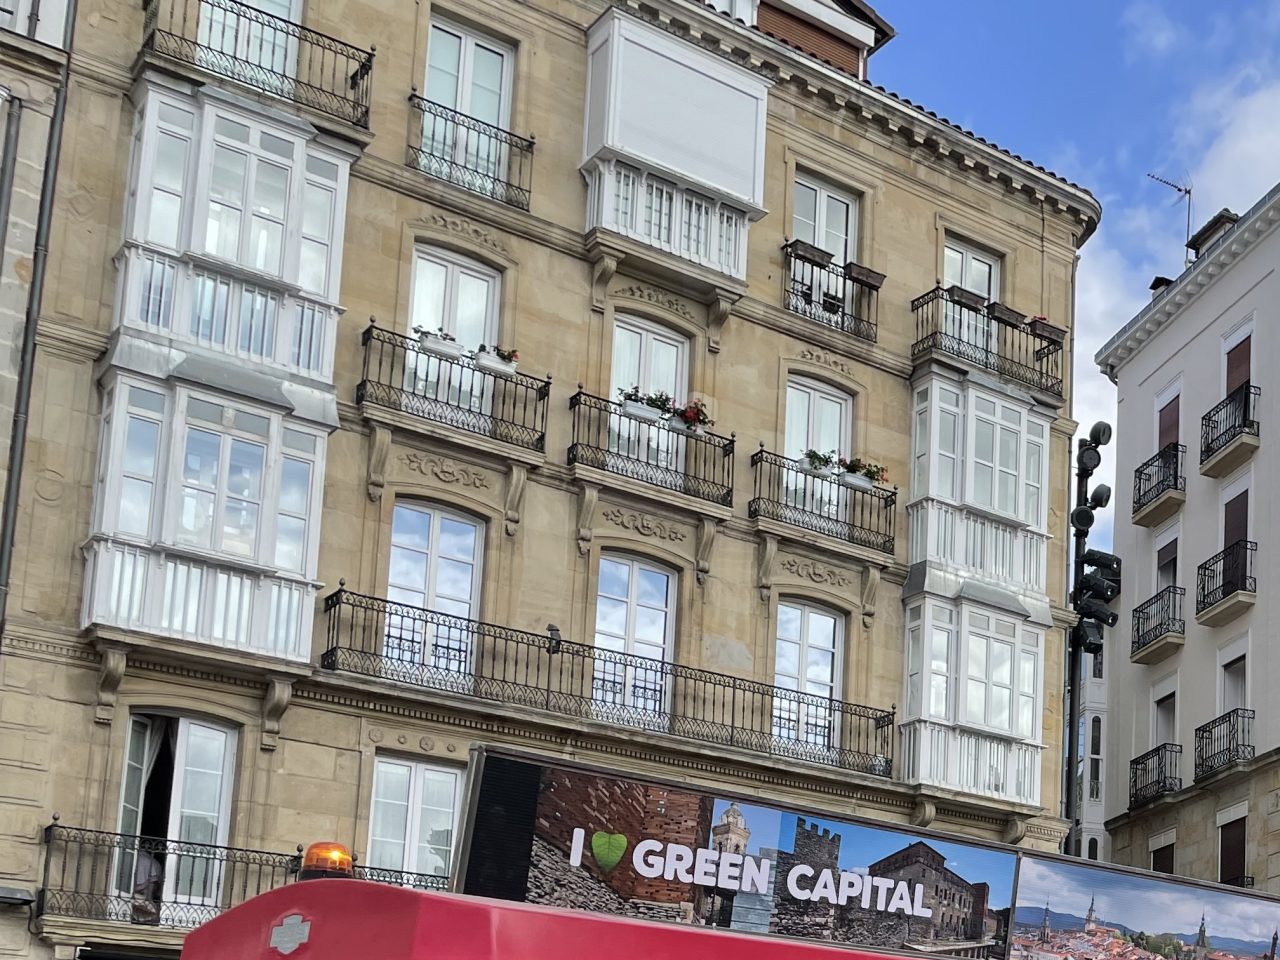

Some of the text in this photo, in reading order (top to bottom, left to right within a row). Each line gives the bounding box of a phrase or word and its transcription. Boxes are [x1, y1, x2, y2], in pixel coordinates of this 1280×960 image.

[569, 827, 933, 918] I GREEN CAPITAL
